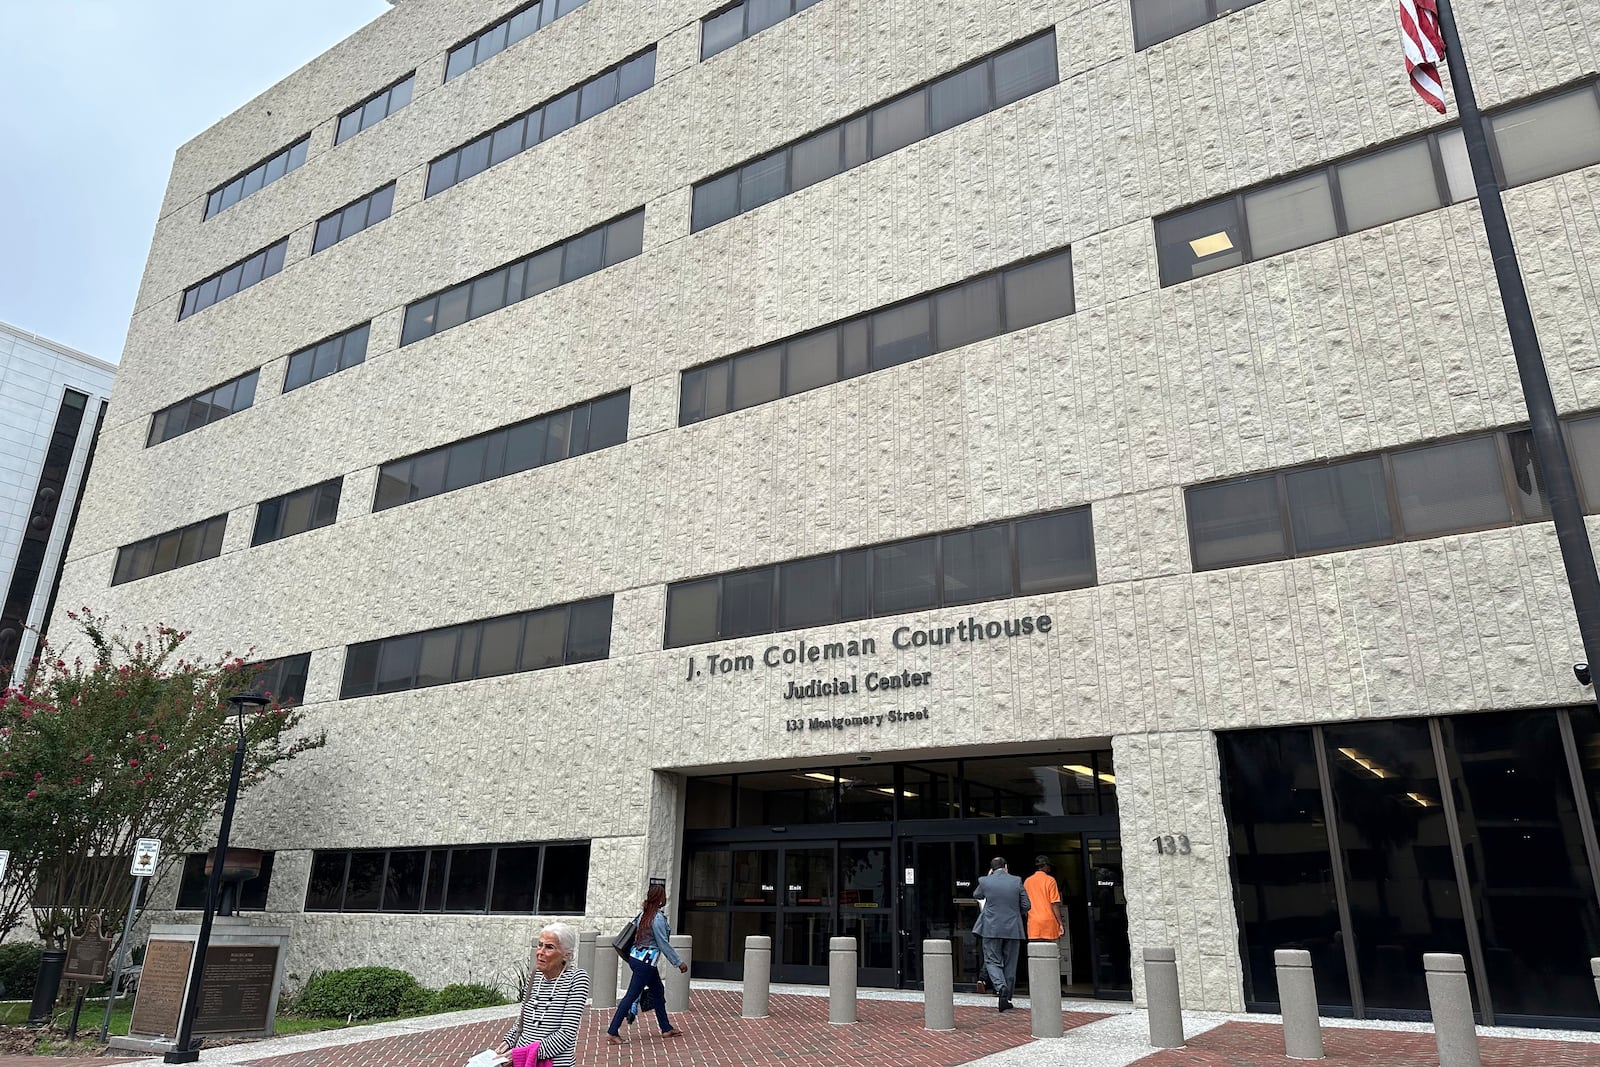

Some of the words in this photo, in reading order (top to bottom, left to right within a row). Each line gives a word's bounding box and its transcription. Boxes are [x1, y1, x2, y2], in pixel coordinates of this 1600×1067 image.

[686, 657, 701, 681] J.
[707, 654, 754, 675] Tom
[763, 637, 876, 667] Coleman
[892, 614, 1052, 650] Courthouse
[784, 675, 858, 699] Judicial
[865, 669, 932, 692] Center
[786, 719, 804, 732] 133
[808, 714, 883, 731] Montgomery
[888, 707, 929, 723] Street
[1152, 834, 1191, 855] 133
